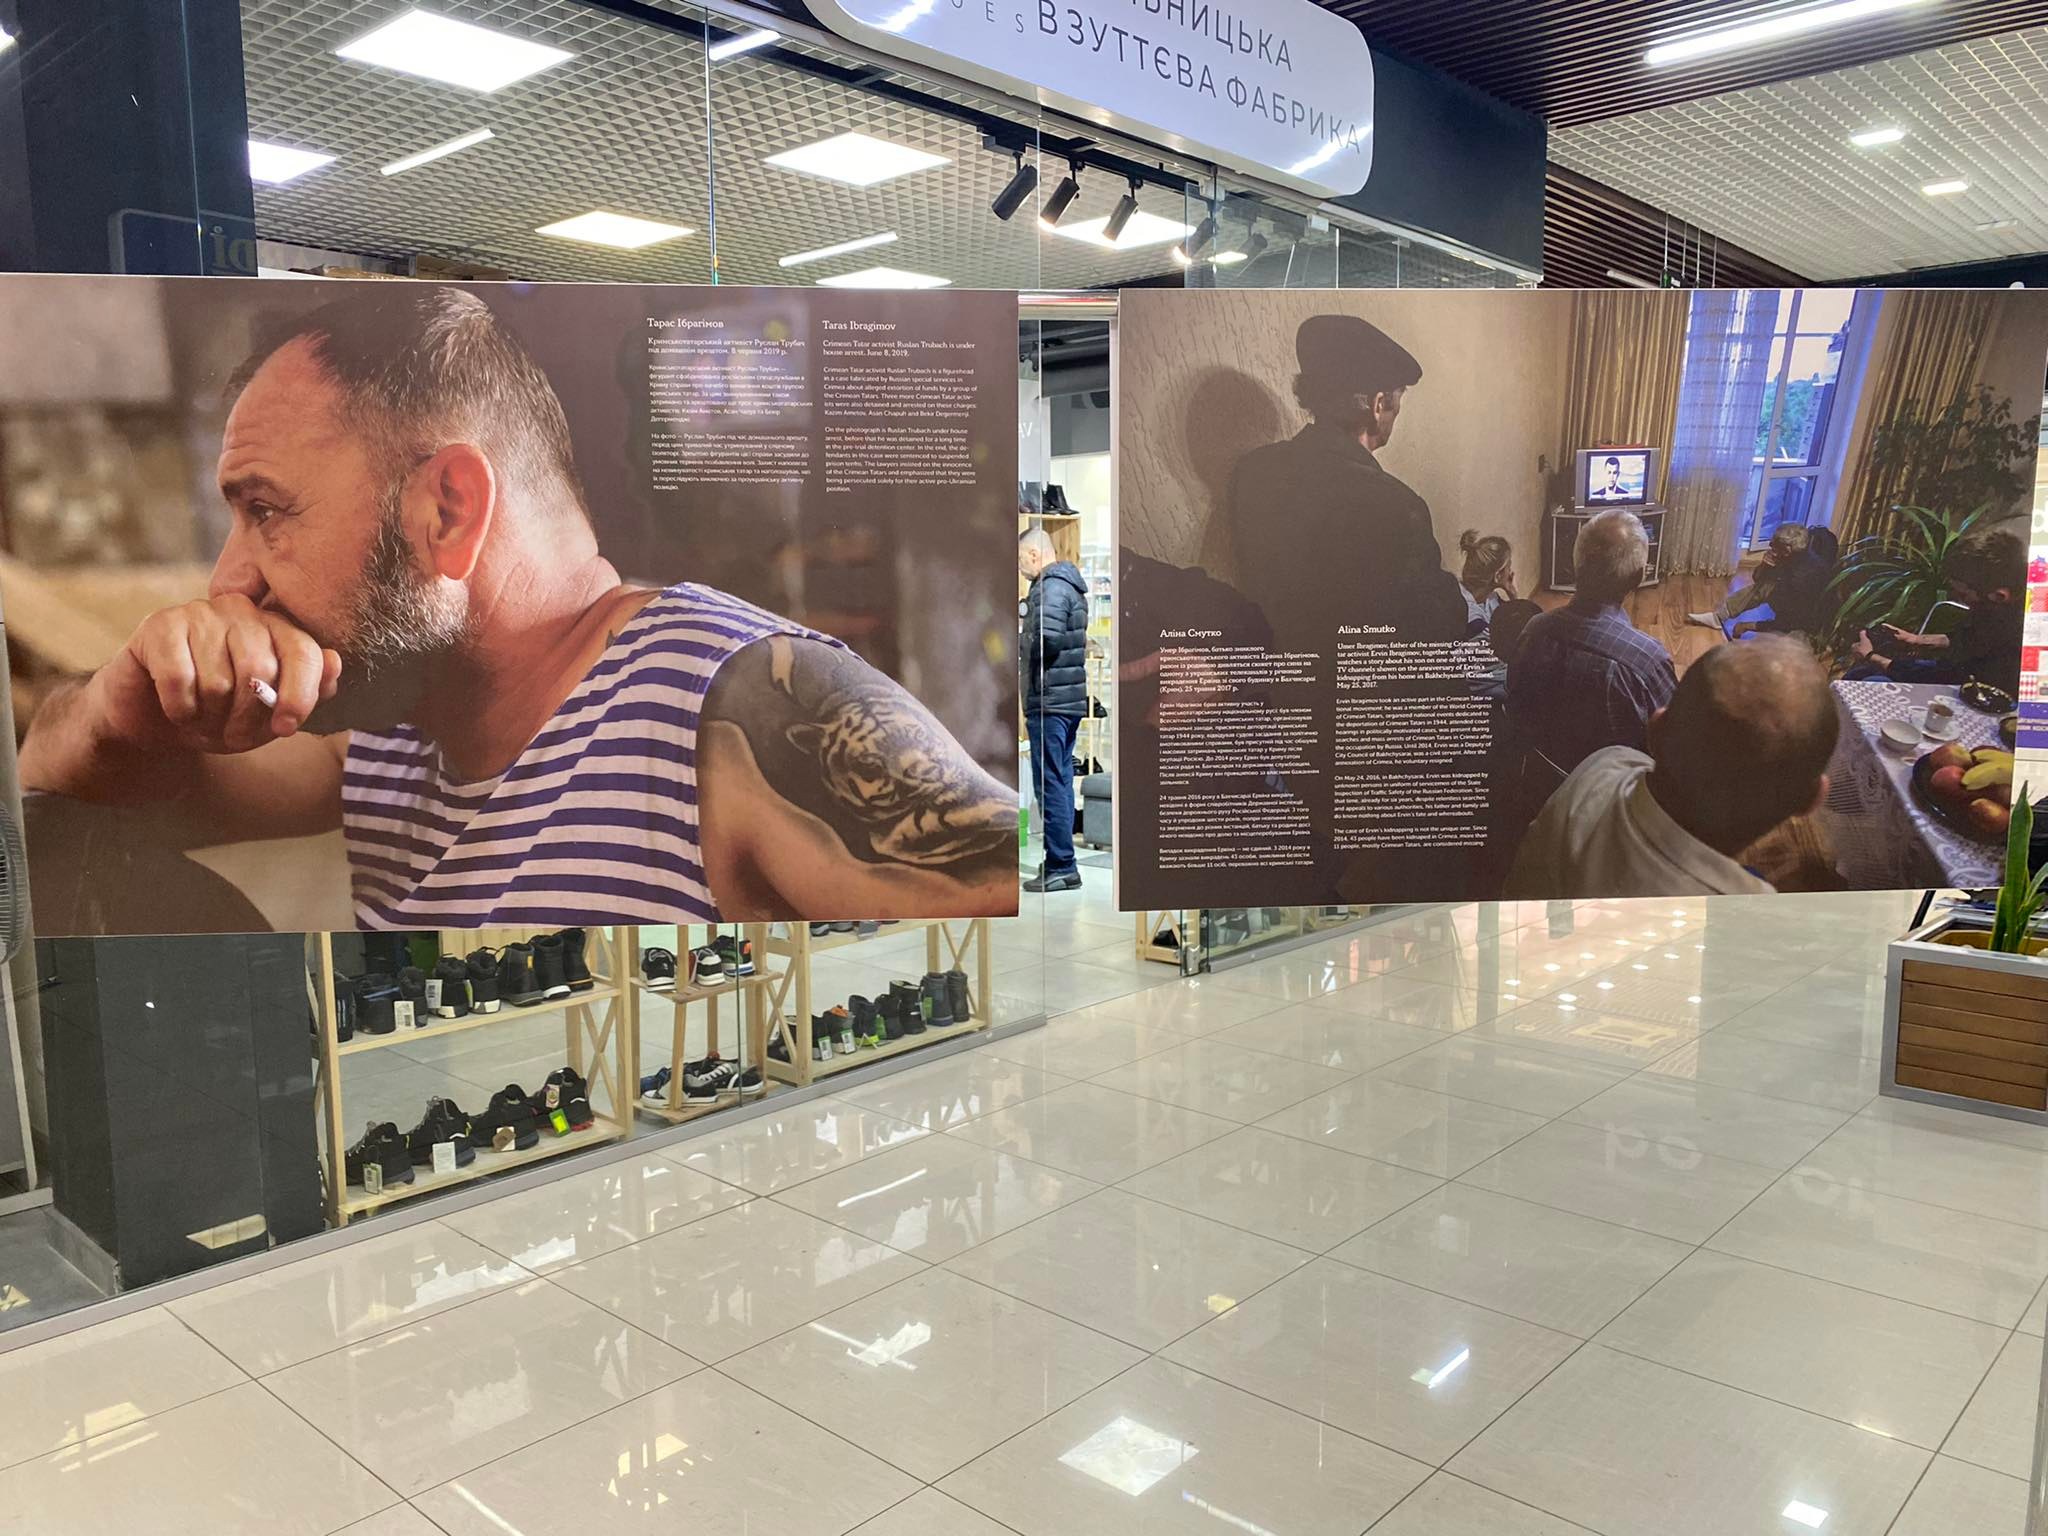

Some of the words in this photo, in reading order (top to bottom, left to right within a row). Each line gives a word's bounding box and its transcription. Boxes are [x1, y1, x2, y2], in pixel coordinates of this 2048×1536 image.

[1132, 0, 1292, 72] НИЦЬКА
[1038, 0, 1217, 98] ВЗУТТЄВА
[1226, 75, 1361, 154] ФАБРИКА
[647, 318, 675, 329] Тарас
[677, 318, 724, 330] Ібрагімов
[822, 320, 847, 330] Taras
[850, 321, 896, 332] Ibragimov
[1160, 629, 1185, 638] Аліна
[1188, 629, 1222, 639] Смутко
[1338, 625, 1360, 634] Alina
[1363, 625, 1396, 634] Smutko
